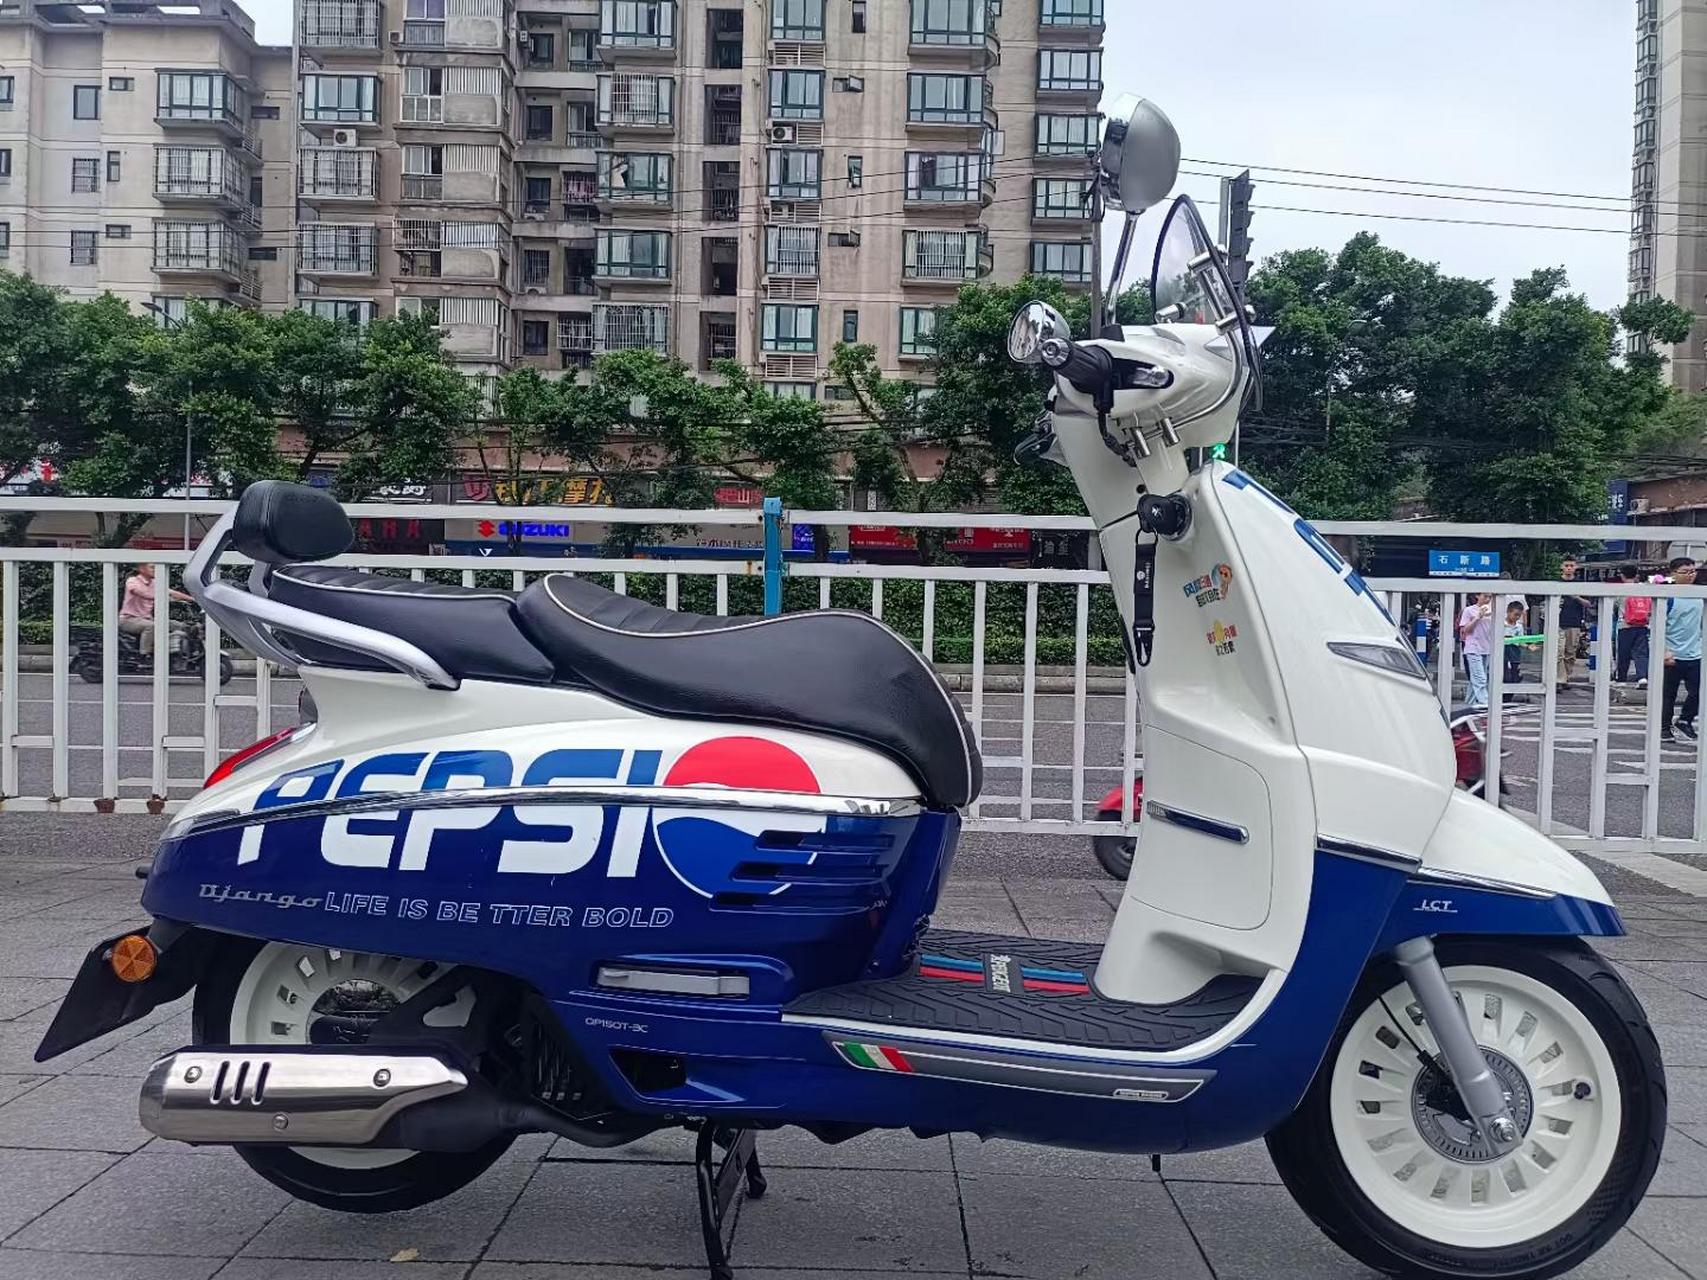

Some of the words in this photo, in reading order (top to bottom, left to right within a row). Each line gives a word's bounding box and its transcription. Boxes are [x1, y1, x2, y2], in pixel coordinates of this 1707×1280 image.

[236, 748, 664, 878] PEPSI
[199, 883, 324, 909] Django
[324, 891, 389, 916] LIFE
[398, 897, 429, 920] IS
[436, 900, 481, 923] BE
[489, 903, 574, 927] TTER
[582, 906, 675, 928] BOLD
[1421, 899, 1453, 911] LCT
